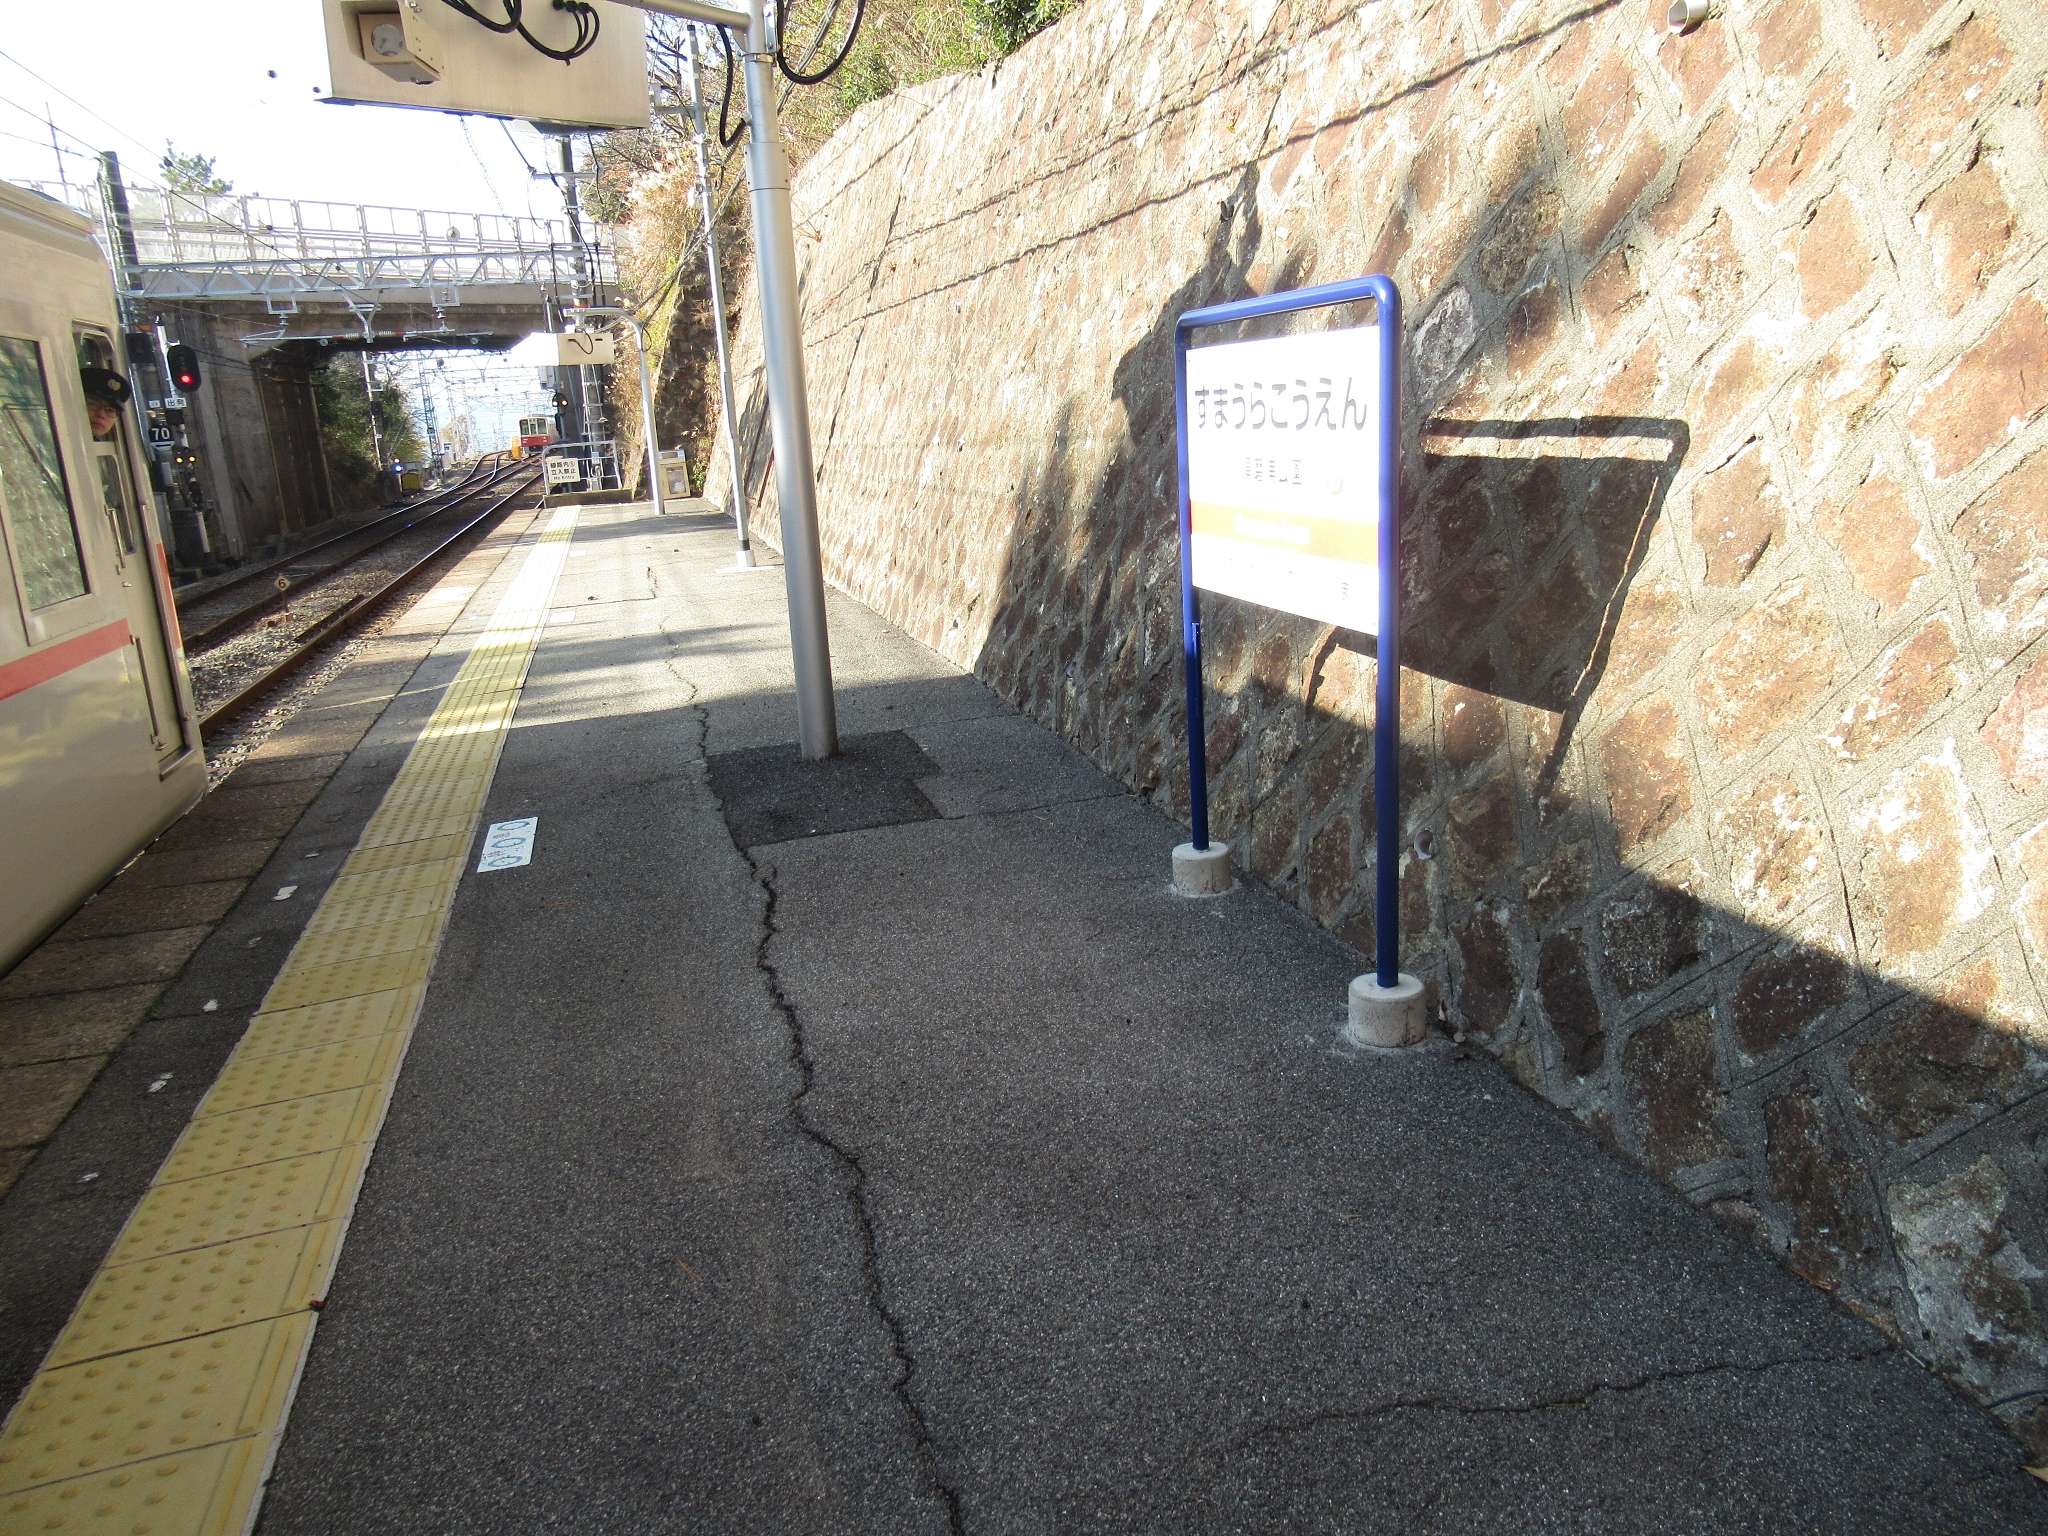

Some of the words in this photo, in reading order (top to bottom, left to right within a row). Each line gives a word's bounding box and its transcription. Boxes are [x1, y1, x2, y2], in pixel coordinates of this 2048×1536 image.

[1194, 376, 1367, 430] すまうらこうえん
[151, 427, 170, 441] 70
